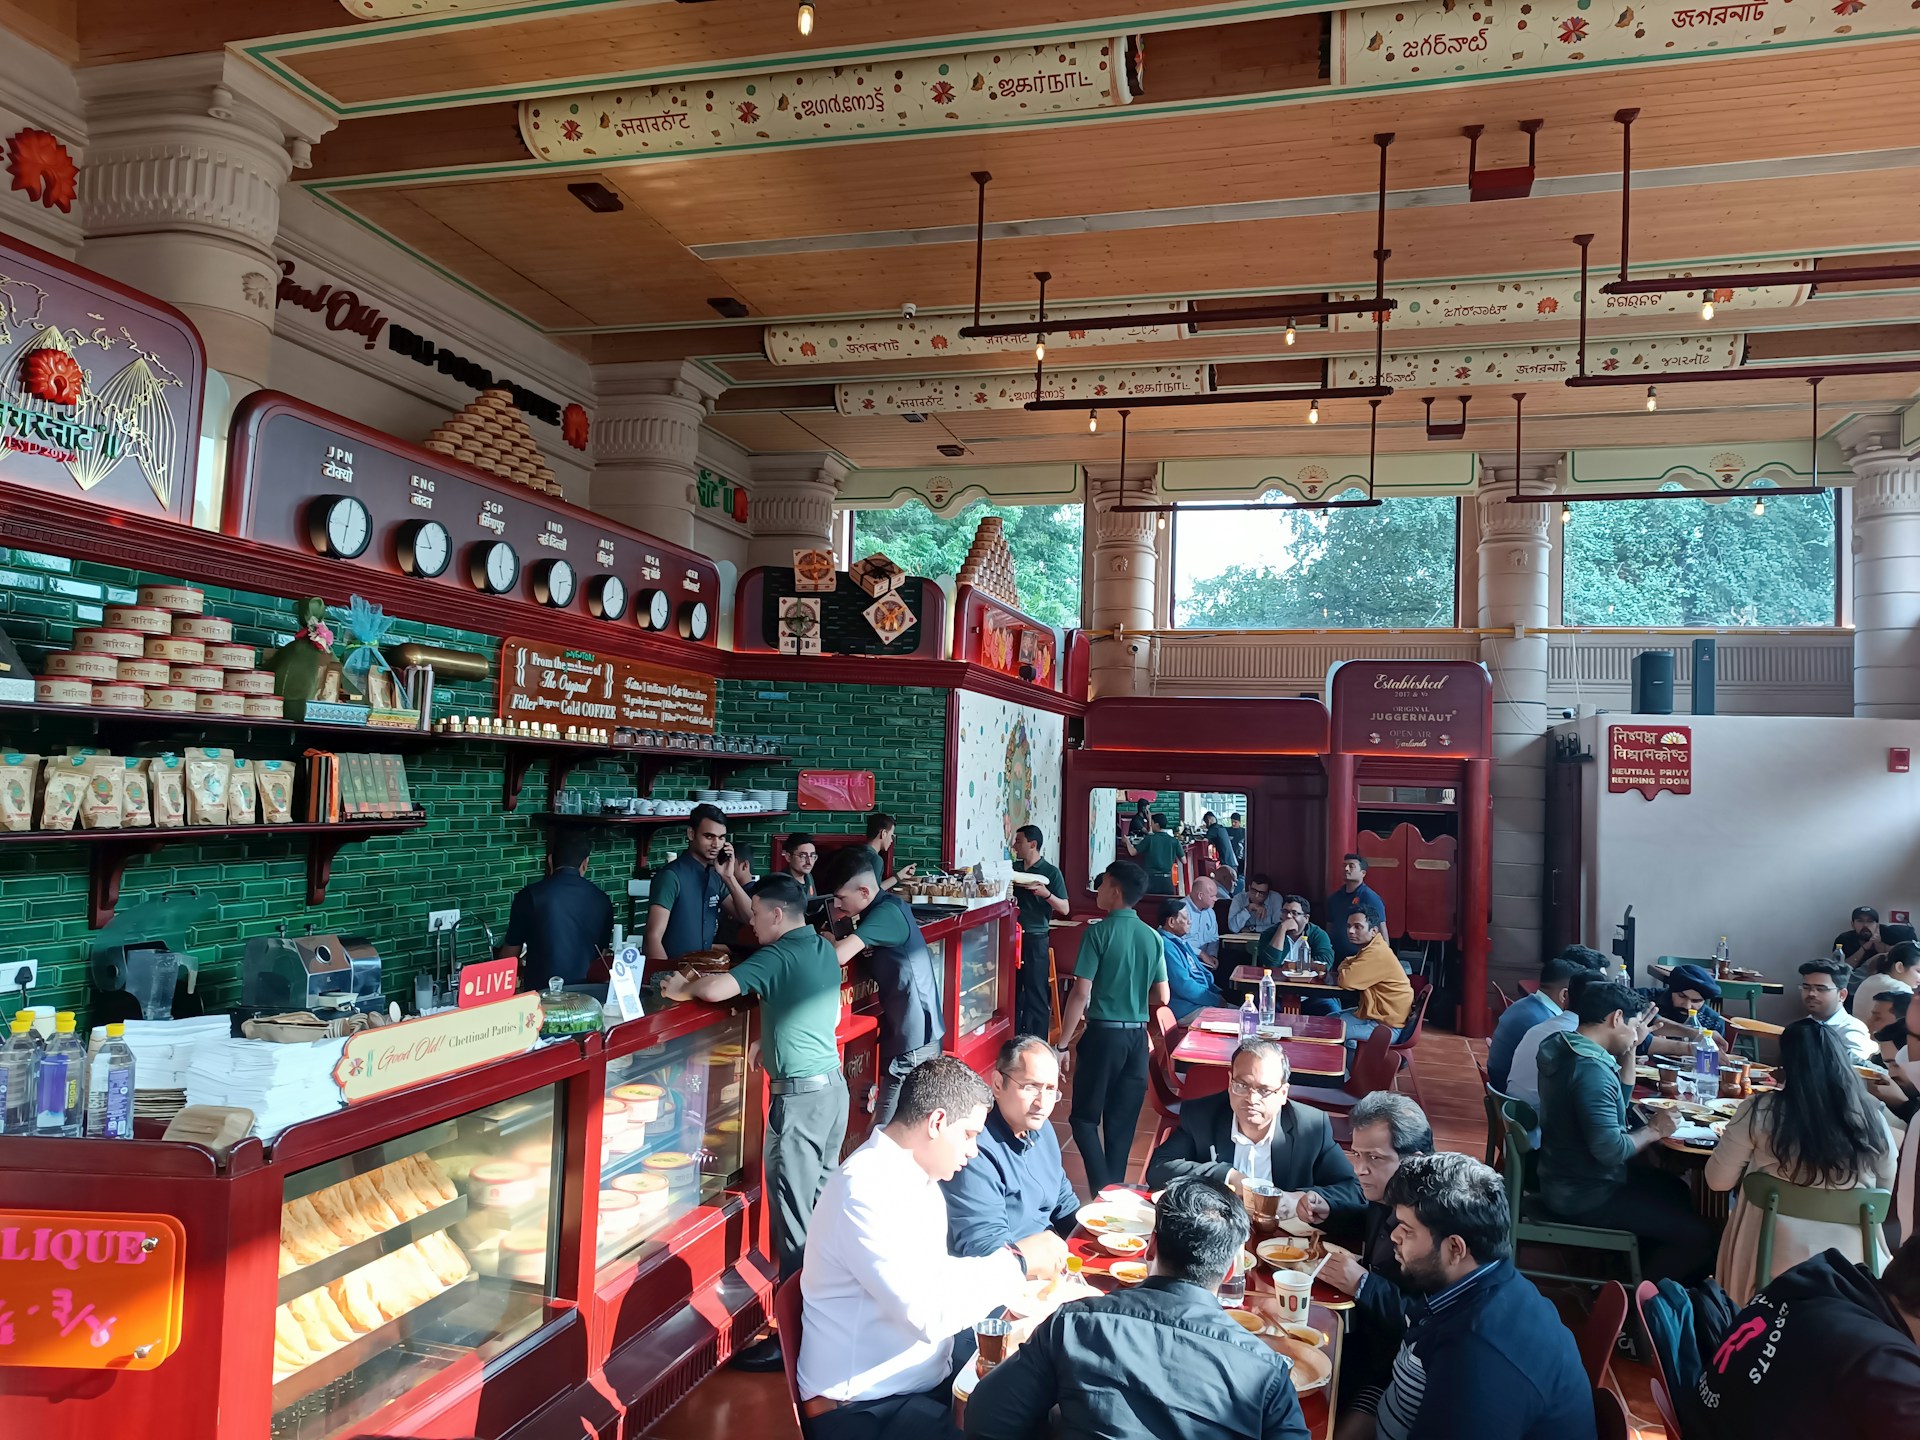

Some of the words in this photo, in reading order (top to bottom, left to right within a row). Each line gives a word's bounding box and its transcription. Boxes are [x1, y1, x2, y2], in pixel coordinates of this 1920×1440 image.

[326, 446, 353, 465] JPN
[410, 475, 435, 492] ENG
[483, 500, 504, 515] SGP
[547, 520, 563, 534] IND
[598, 538, 614, 551] AUS
[644, 554, 660, 567] USA
[530, 652, 553, 668] From
[553, 655, 567, 671] the
[593, 663, 602, 676] of
[1374, 673, 1449, 689] Established
[511, 693, 538, 710] Filter
[581, 701, 617, 719] COFFEE
[1389, 729, 1413, 738] OPEN
[1417, 730, 1432, 738] AIR
[1611, 767, 1656, 776] NEUTRAL
[1659, 768, 1689, 776] PRIVY
[1611, 776, 1656, 785] RETIRING
[475, 969, 515, 997] LIVE
[377, 1039, 412, 1071] Good
[414, 1034, 446, 1059] Old!
[448, 1026, 490, 1049] Chettinad
[491, 1021, 517, 1038] Patties
